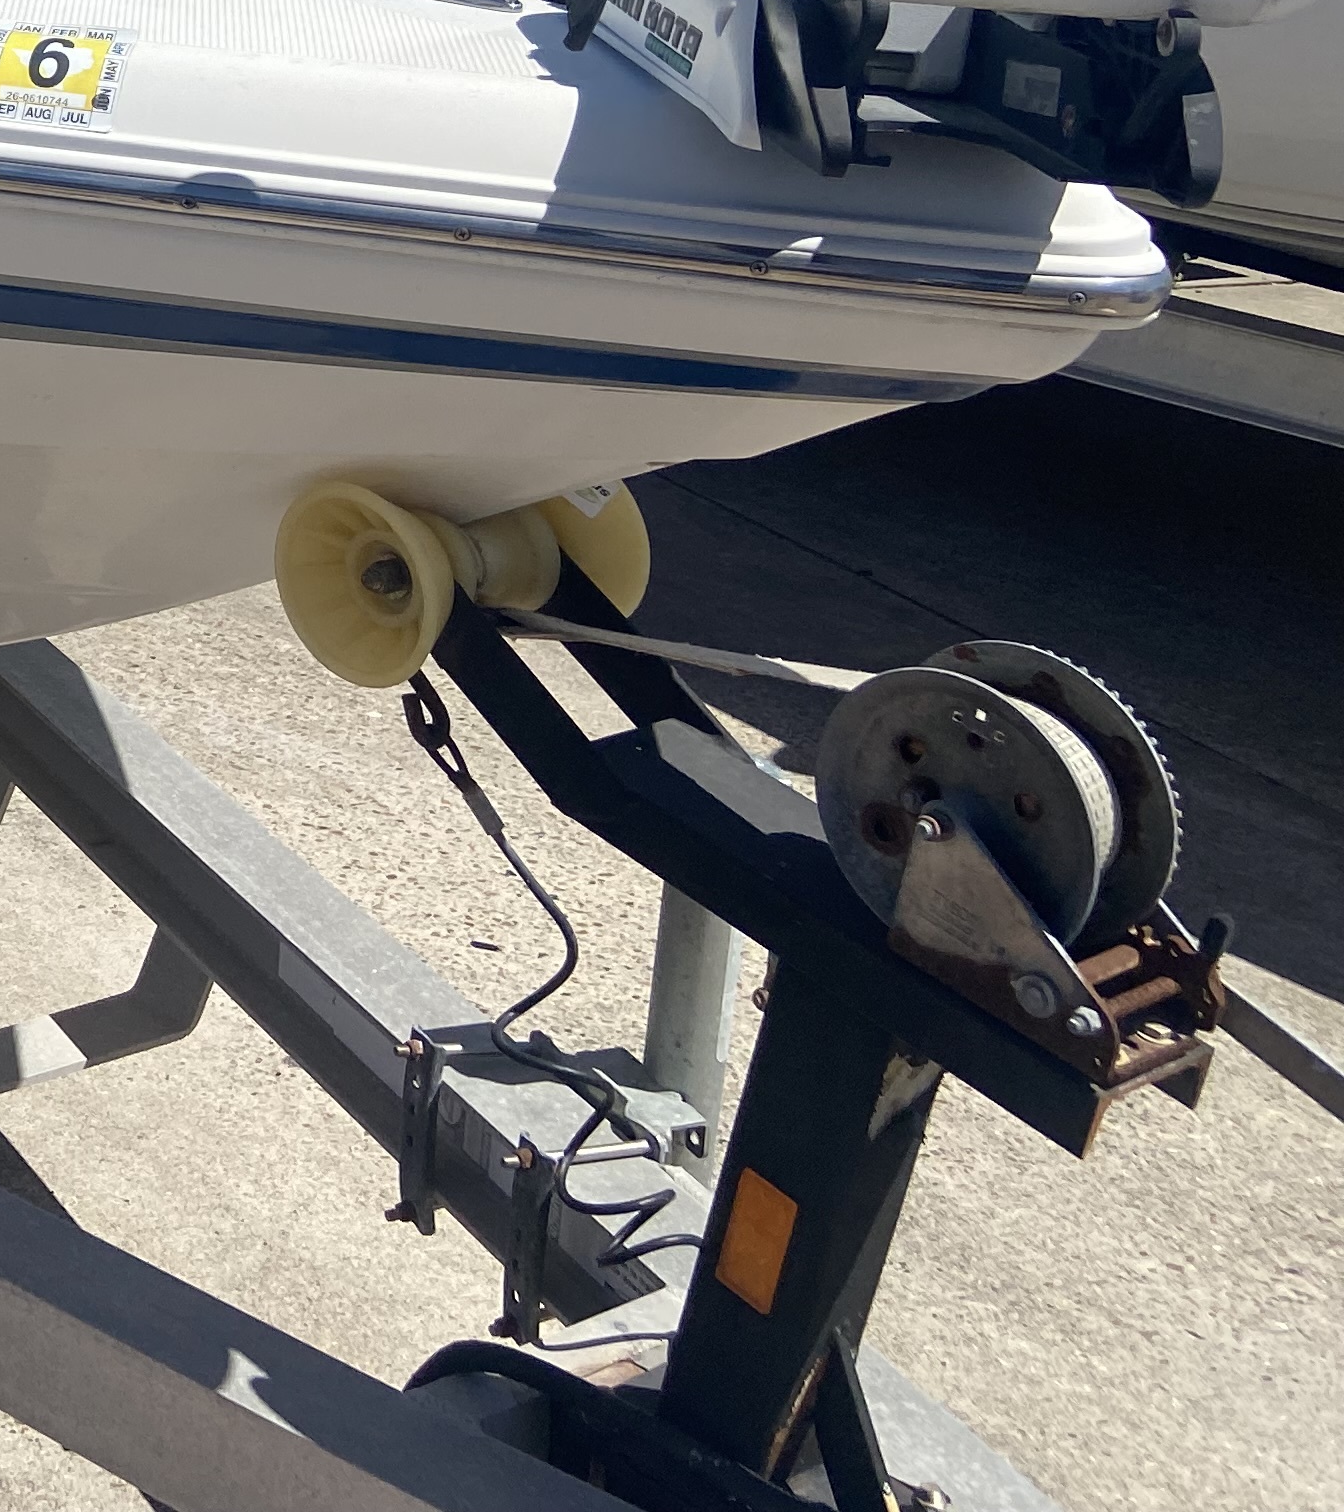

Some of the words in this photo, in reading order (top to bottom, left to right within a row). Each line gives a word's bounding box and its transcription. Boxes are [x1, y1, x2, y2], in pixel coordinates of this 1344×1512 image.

[15, 23, 42, 34] JAN
[87, 31, 114, 41] MAR
[28, 37, 75, 88] 6
[103, 60, 119, 81] MAY
[97, 88, 112, 112] JUN
[25, 107, 52, 121] AUG
[62, 112, 88, 125] JUL
